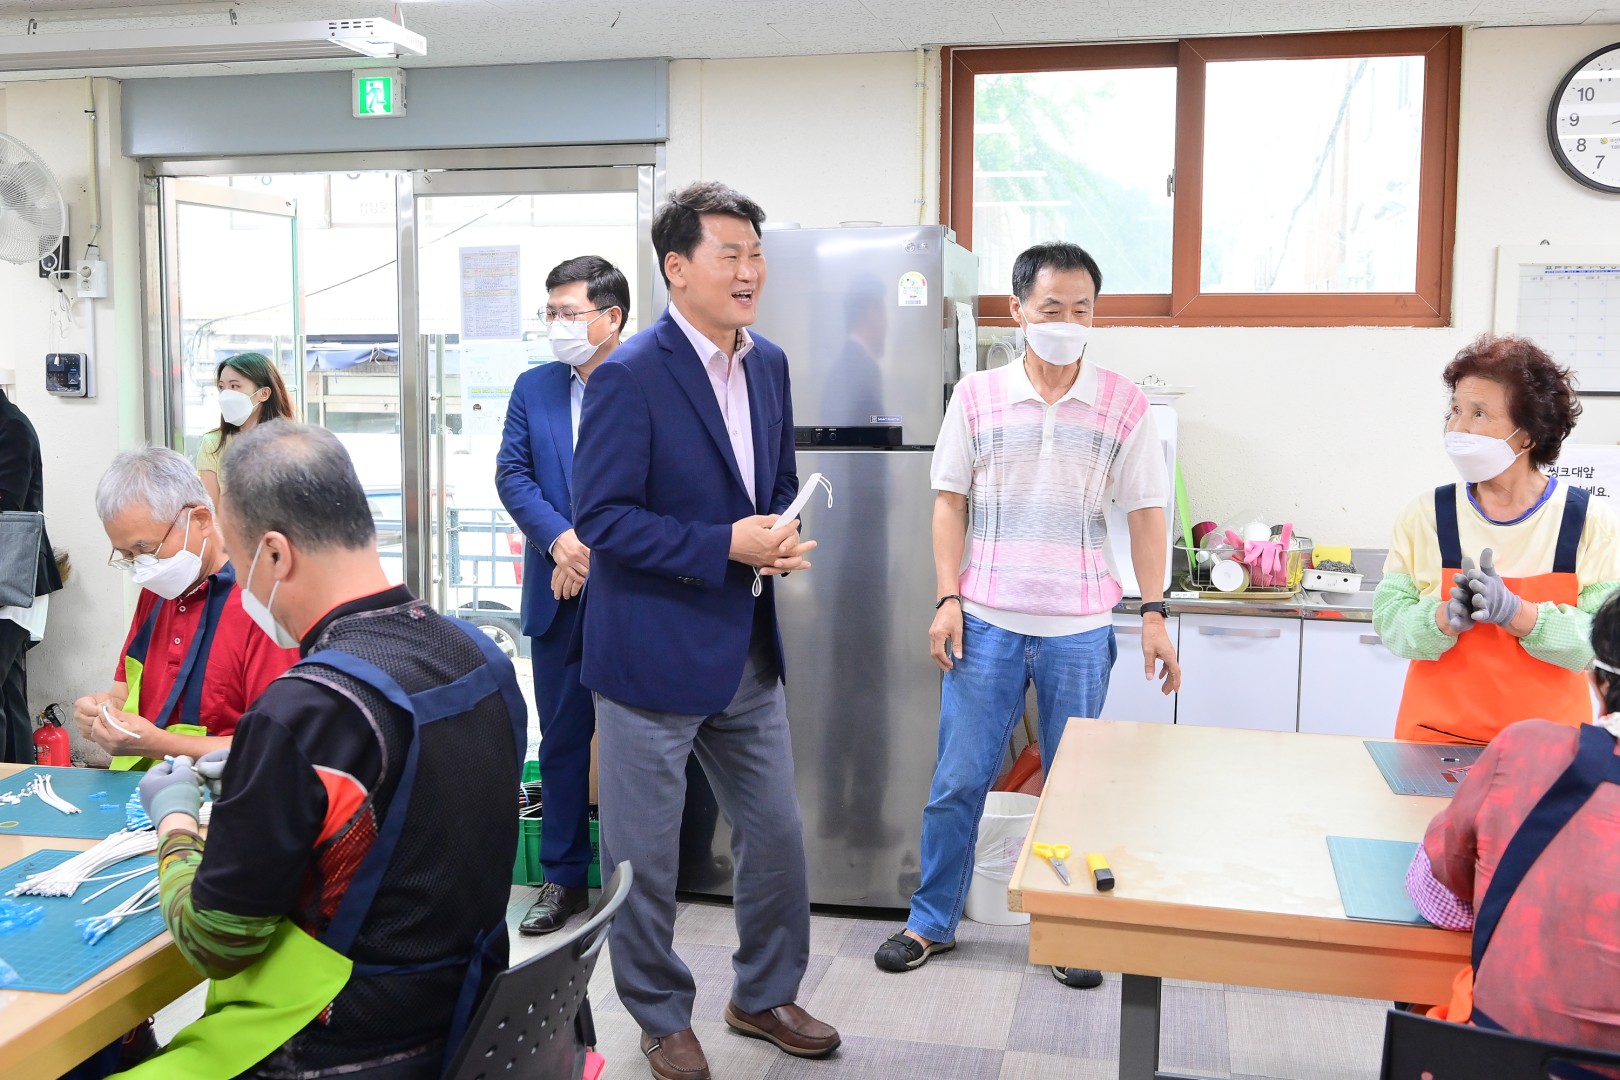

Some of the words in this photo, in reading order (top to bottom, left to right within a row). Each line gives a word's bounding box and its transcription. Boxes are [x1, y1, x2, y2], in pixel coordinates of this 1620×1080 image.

[1577, 87, 1595, 101] 10
[1569, 112, 1580, 127] 9
[1576, 138, 1587, 152] 8
[1595, 155, 1605, 169] 7
[1547, 466, 1595, 479] 씽크대앞
